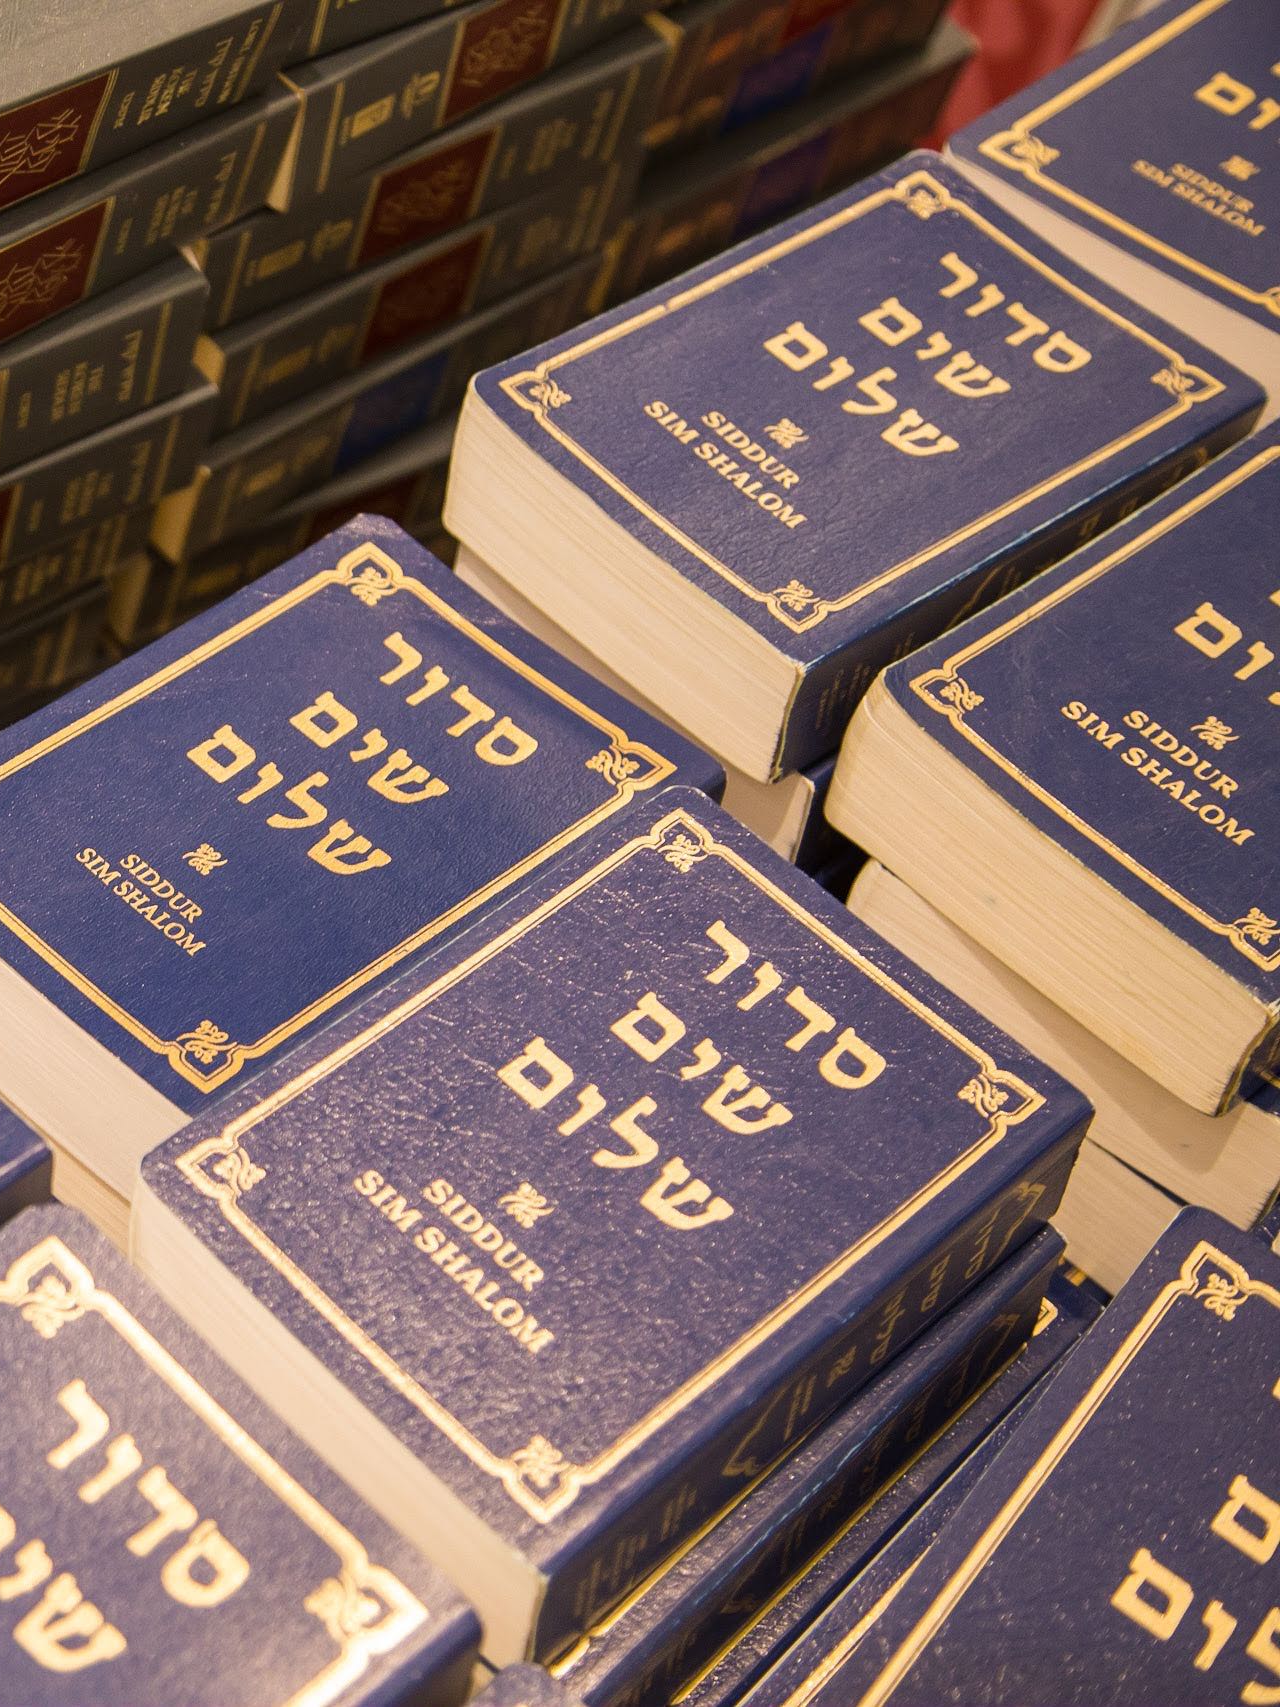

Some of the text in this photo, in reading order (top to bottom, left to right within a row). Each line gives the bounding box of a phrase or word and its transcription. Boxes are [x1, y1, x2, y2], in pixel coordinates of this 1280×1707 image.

[1130, 159, 1266, 237] SIM SHALOM
[1170, 162, 1255, 213] SIDDUR
[858, 296, 1011, 399] שים
[939, 252, 1091, 373] סדור
[701, 411, 799, 490] SIDDUR
[763, 321, 959, 457] שלום
[644, 400, 806, 528] SIM SHALOM
[289, 691, 448, 804] שים
[379, 632, 538, 766] סדור
[1122, 710, 1238, 800] SIDDUR
[187, 724, 391, 875] שלום
[1060, 701, 1254, 845] SIM SHALOM
[76, 848, 205, 955] SIM SHALOM
[120, 854, 202, 923] SIDDUR
[609, 992, 792, 1136] שים
[704, 919, 886, 1089] סדור
[496, 1036, 733, 1231] שלום
[353, 1170, 555, 1354] SIM SHALOM
[426, 1178, 543, 1292] SIDDUR
[45, 1378, 251, 1608] סדור
